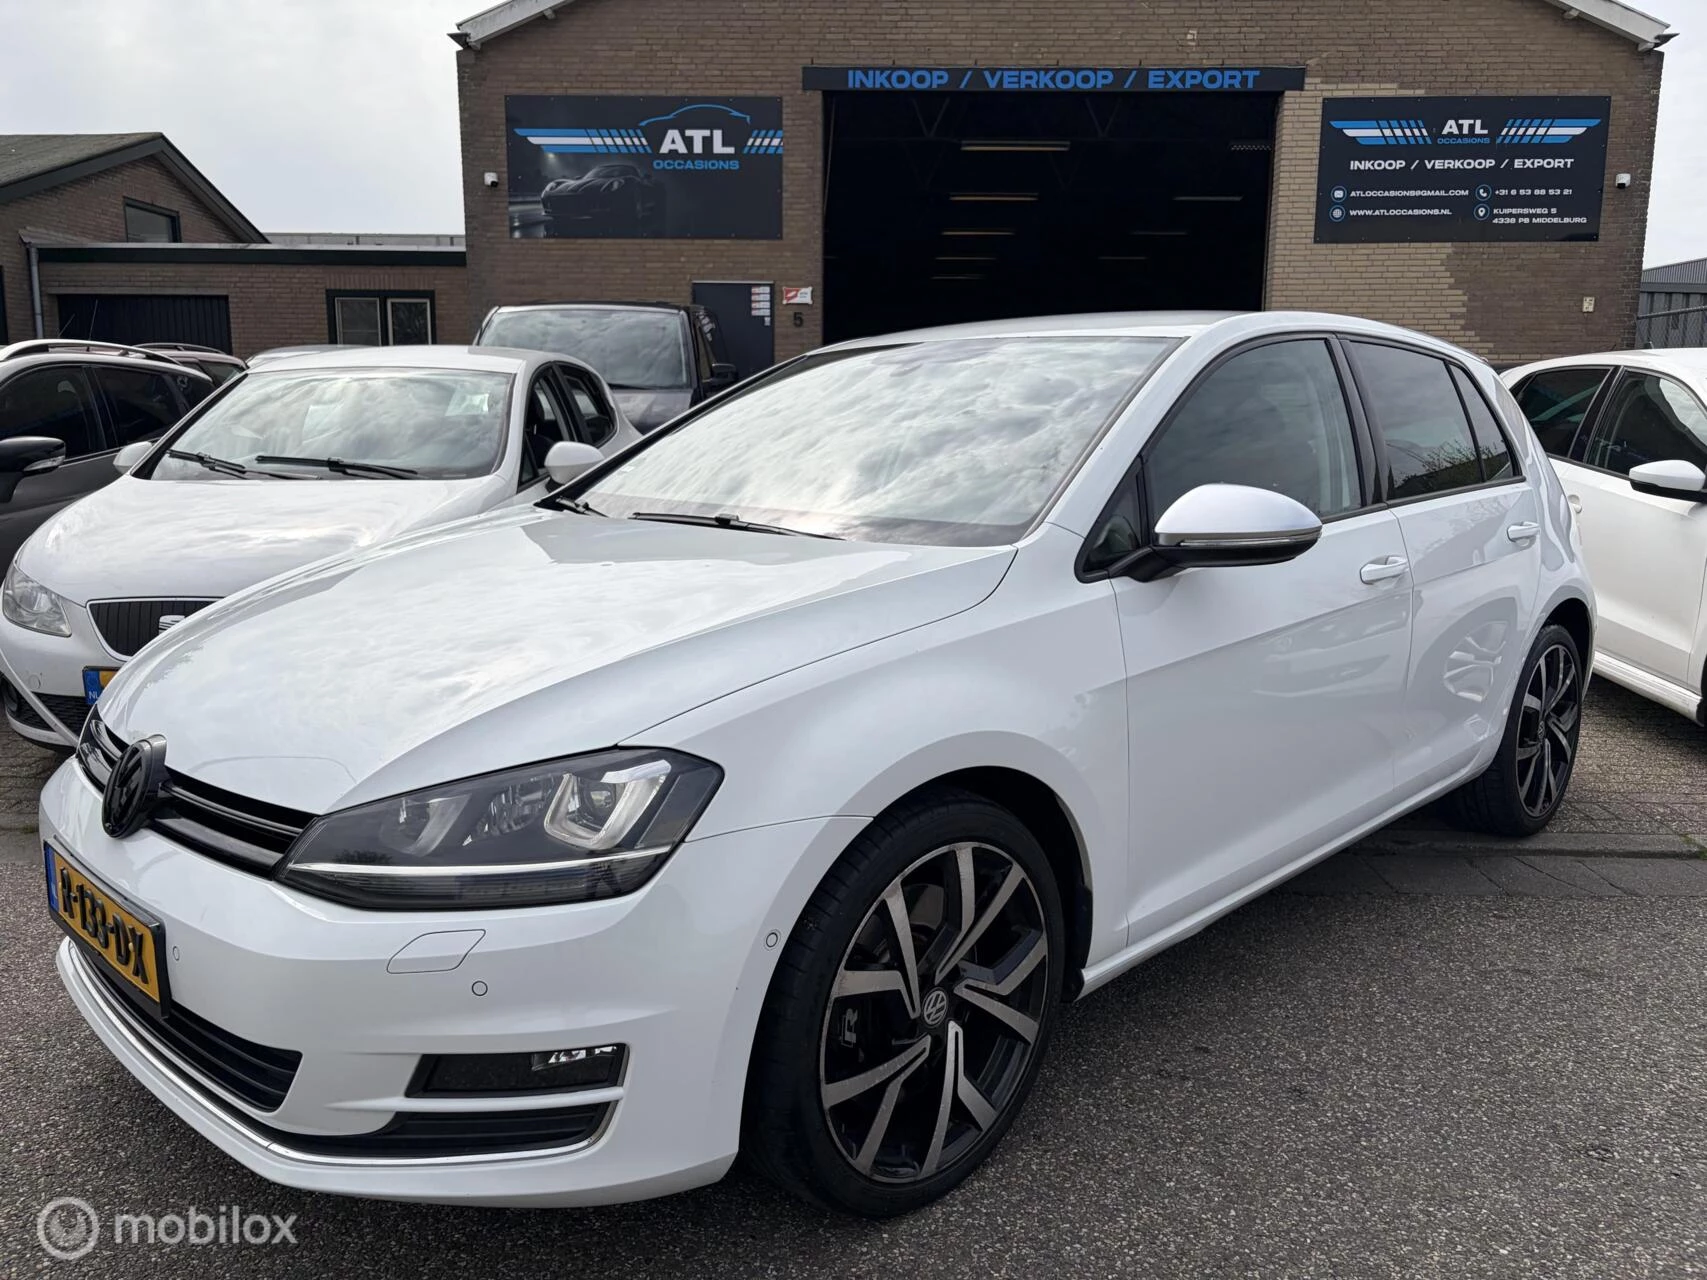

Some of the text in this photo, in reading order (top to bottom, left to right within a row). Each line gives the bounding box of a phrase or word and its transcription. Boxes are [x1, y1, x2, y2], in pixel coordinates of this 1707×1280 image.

[847, 69, 949, 89] INKOOP
[983, 69, 1114, 89] VERKOOP
[1148, 69, 1261, 89] EXPORT
[1441, 119, 1489, 135] ATL
[659, 129, 735, 154] ATL
[1437, 137, 1490, 145] OCCASIONS
[652, 159, 740, 171] OCCASIONS
[1350, 160, 1406, 170] INKOOP
[1424, 159, 1496, 170] VERKOOP
[1513, 158, 1574, 169] EXPORT
[1350, 189, 1469, 197] ATLOCCASIONS@GMAIL.COM
[1349, 208, 1452, 216] WWW.ATLOCCASIONS.NL
[793, 311, 804, 327] 5
